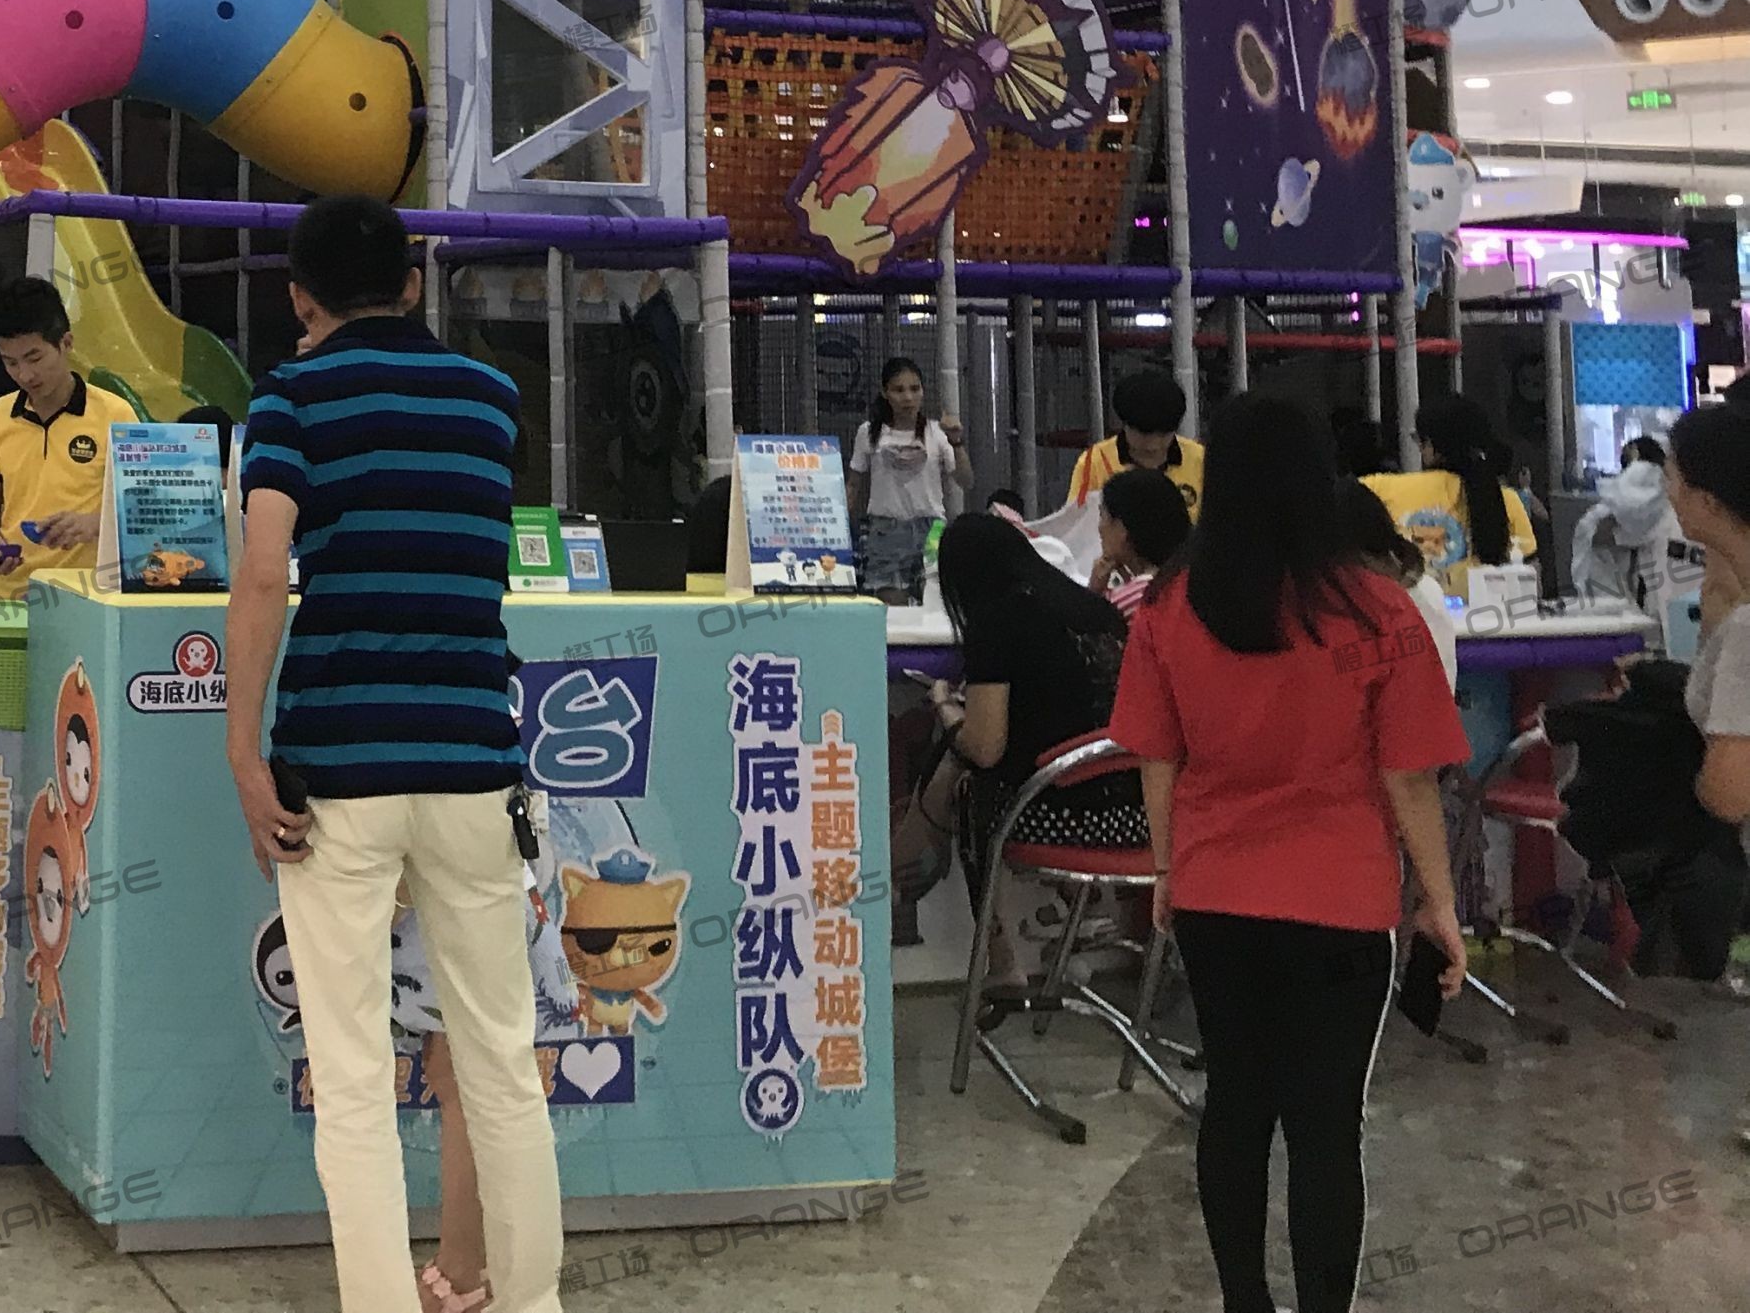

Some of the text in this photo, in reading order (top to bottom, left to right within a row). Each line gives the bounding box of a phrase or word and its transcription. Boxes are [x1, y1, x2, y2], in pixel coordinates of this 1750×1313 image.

[732, 659, 804, 1068] 海底小纵队
[811, 741, 864, 1086] 主题移动城堡
